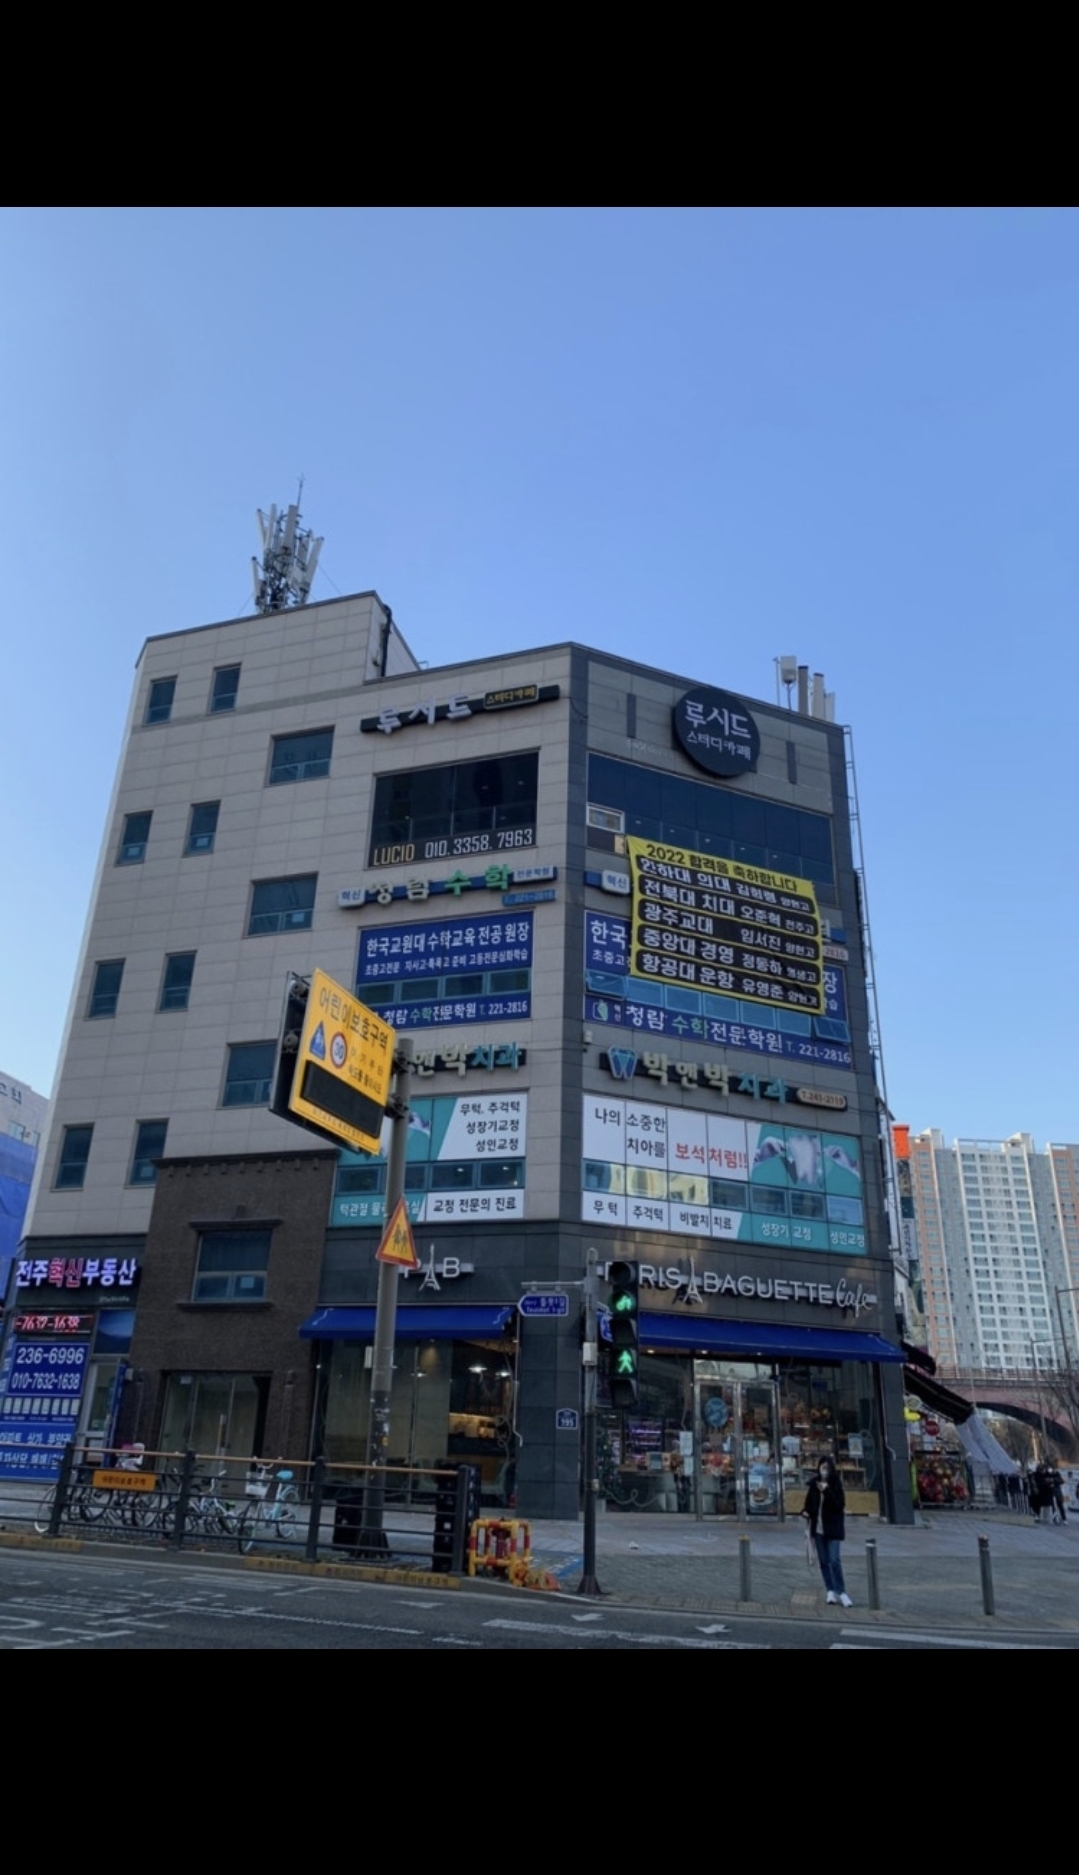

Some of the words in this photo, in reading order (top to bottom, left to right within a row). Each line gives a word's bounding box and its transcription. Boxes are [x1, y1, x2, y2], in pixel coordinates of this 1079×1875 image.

[685, 699, 751, 738] 루시드
[686, 731, 751, 760] 스터디카페
[373, 844, 414, 867] LUCIO
[645, 844, 686, 865] 2022
[689, 853, 729, 875] 합격을
[733, 865, 797, 892] 축하합니다
[607, 872, 628, 888] 혁신
[697, 872, 731, 892] 의대
[644, 878, 695, 907] 전북대
[702, 893, 735, 916] 치대
[740, 905, 781, 927] 오준혁
[644, 902, 714, 935] 광주교대
[740, 928, 781, 951] 임서진
[366, 933, 426, 958] 한국교원대
[427, 927, 475, 951] 수학교육
[478, 924, 502, 945] 전공
[505, 922, 529, 943] 원장
[643, 928, 695, 956] 중앙대
[700, 941, 734, 965] 경영
[642, 953, 695, 981] 항공대
[700, 967, 735, 990] 운항
[742, 978, 784, 1000] 유영준
[488, 1001, 528, 1016] 221-2816
[626, 1003, 666, 1031] 청람
[799, 1042, 851, 1064] 221-2816
[488, 1100, 520, 1113] 주걱턱
[594, 1107, 620, 1127] 나의
[627, 1113, 666, 1133] 소중한
[476, 1138, 519, 1152] 성인교정
[627, 1137, 666, 1158] 치아를
[433, 1199, 455, 1213] 교정
[459, 1197, 491, 1213] 전문의
[495, 1196, 517, 1210] 진료
[632, 1205, 664, 1222] 주걱턱
[680, 1211, 709, 1228] 비발치
[713, 1215, 733, 1231] 치료
[761, 1221, 789, 1238] 성장기
[793, 1226, 812, 1241] 교정
[16, 1257, 136, 1288] 전주혁신부동산
[443, 1257, 461, 1278] B
[703, 1271, 833, 1305] BAGUETTE
[836, 1278, 876, 1318] Cafe
[17, 1347, 84, 1364] 236-6996
[12, 1372, 81, 1389] 010-7632-1638
